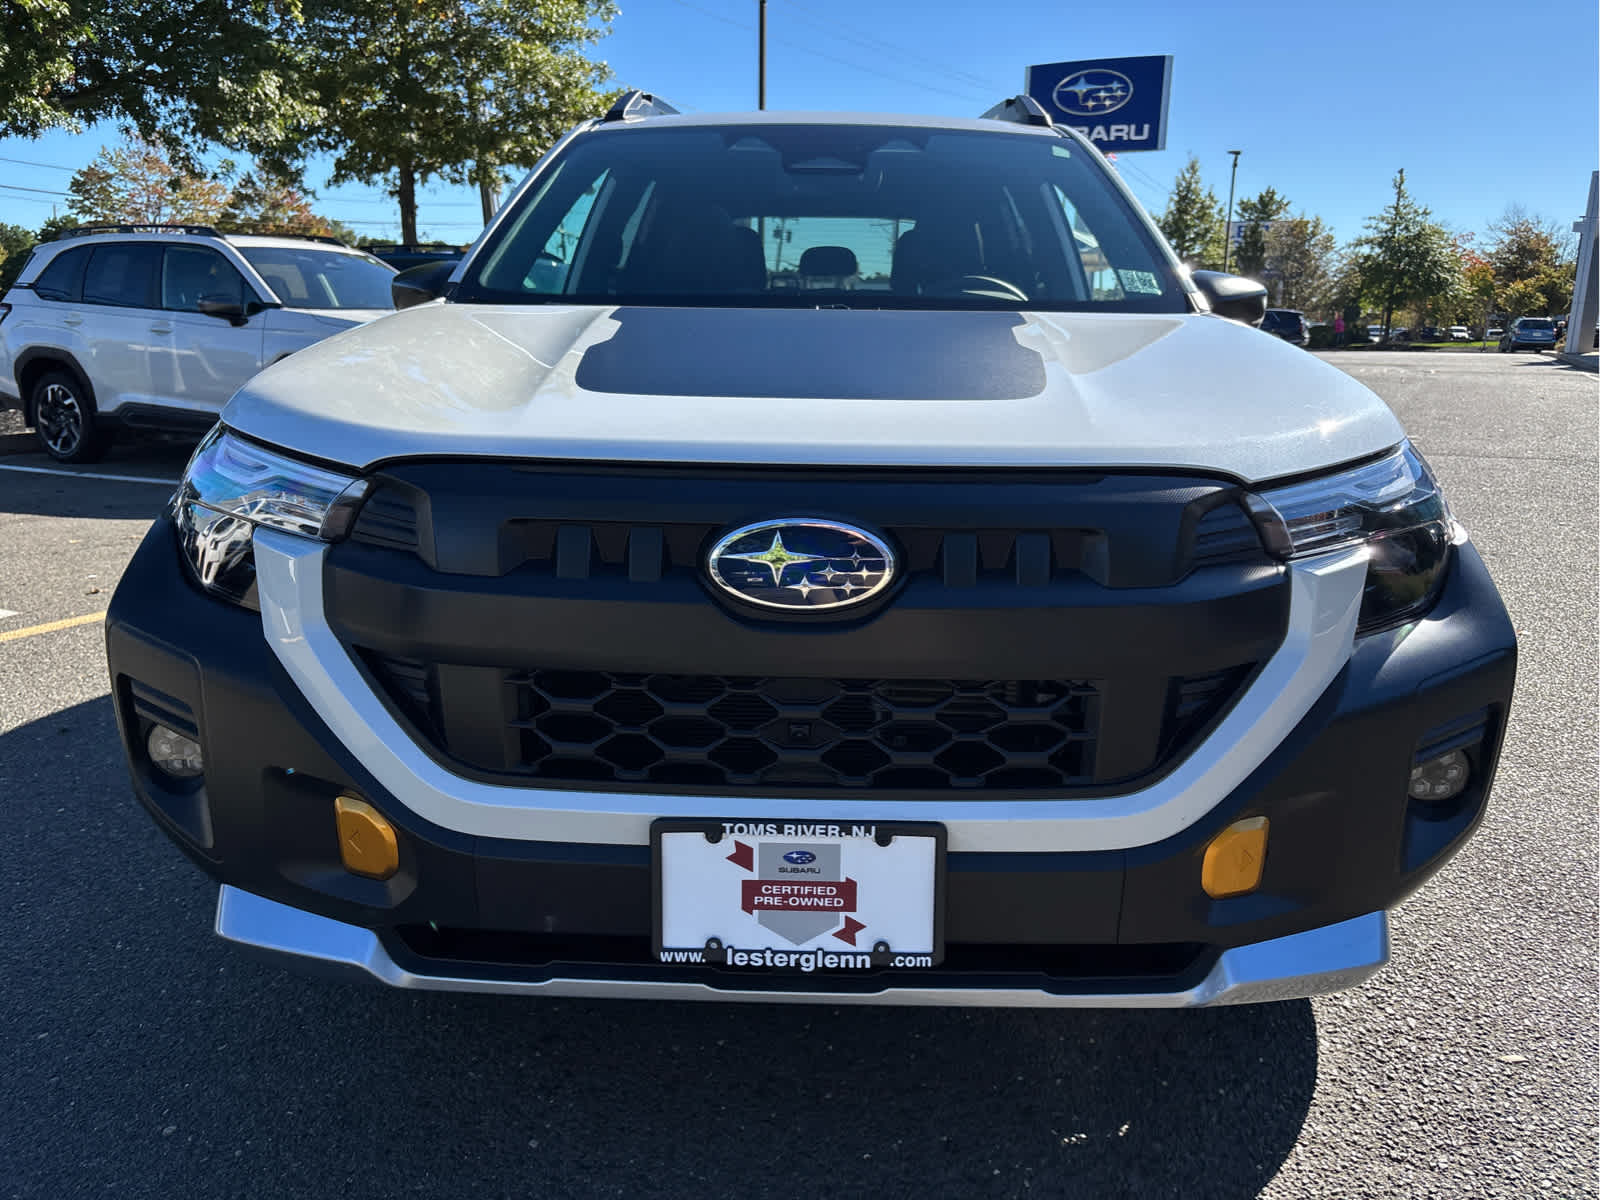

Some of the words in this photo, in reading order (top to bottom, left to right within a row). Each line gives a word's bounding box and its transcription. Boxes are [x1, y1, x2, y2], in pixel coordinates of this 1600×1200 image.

[722, 823, 777, 837] TOMS
[852, 825, 876, 838] NJ
[761, 885, 837, 896] CERTIFIED
[754, 896, 844, 907] PRE-OWNED
[660, 951, 706, 963] www.
[726, 948, 871, 972] lesterglenn
[890, 953, 932, 968] .com
